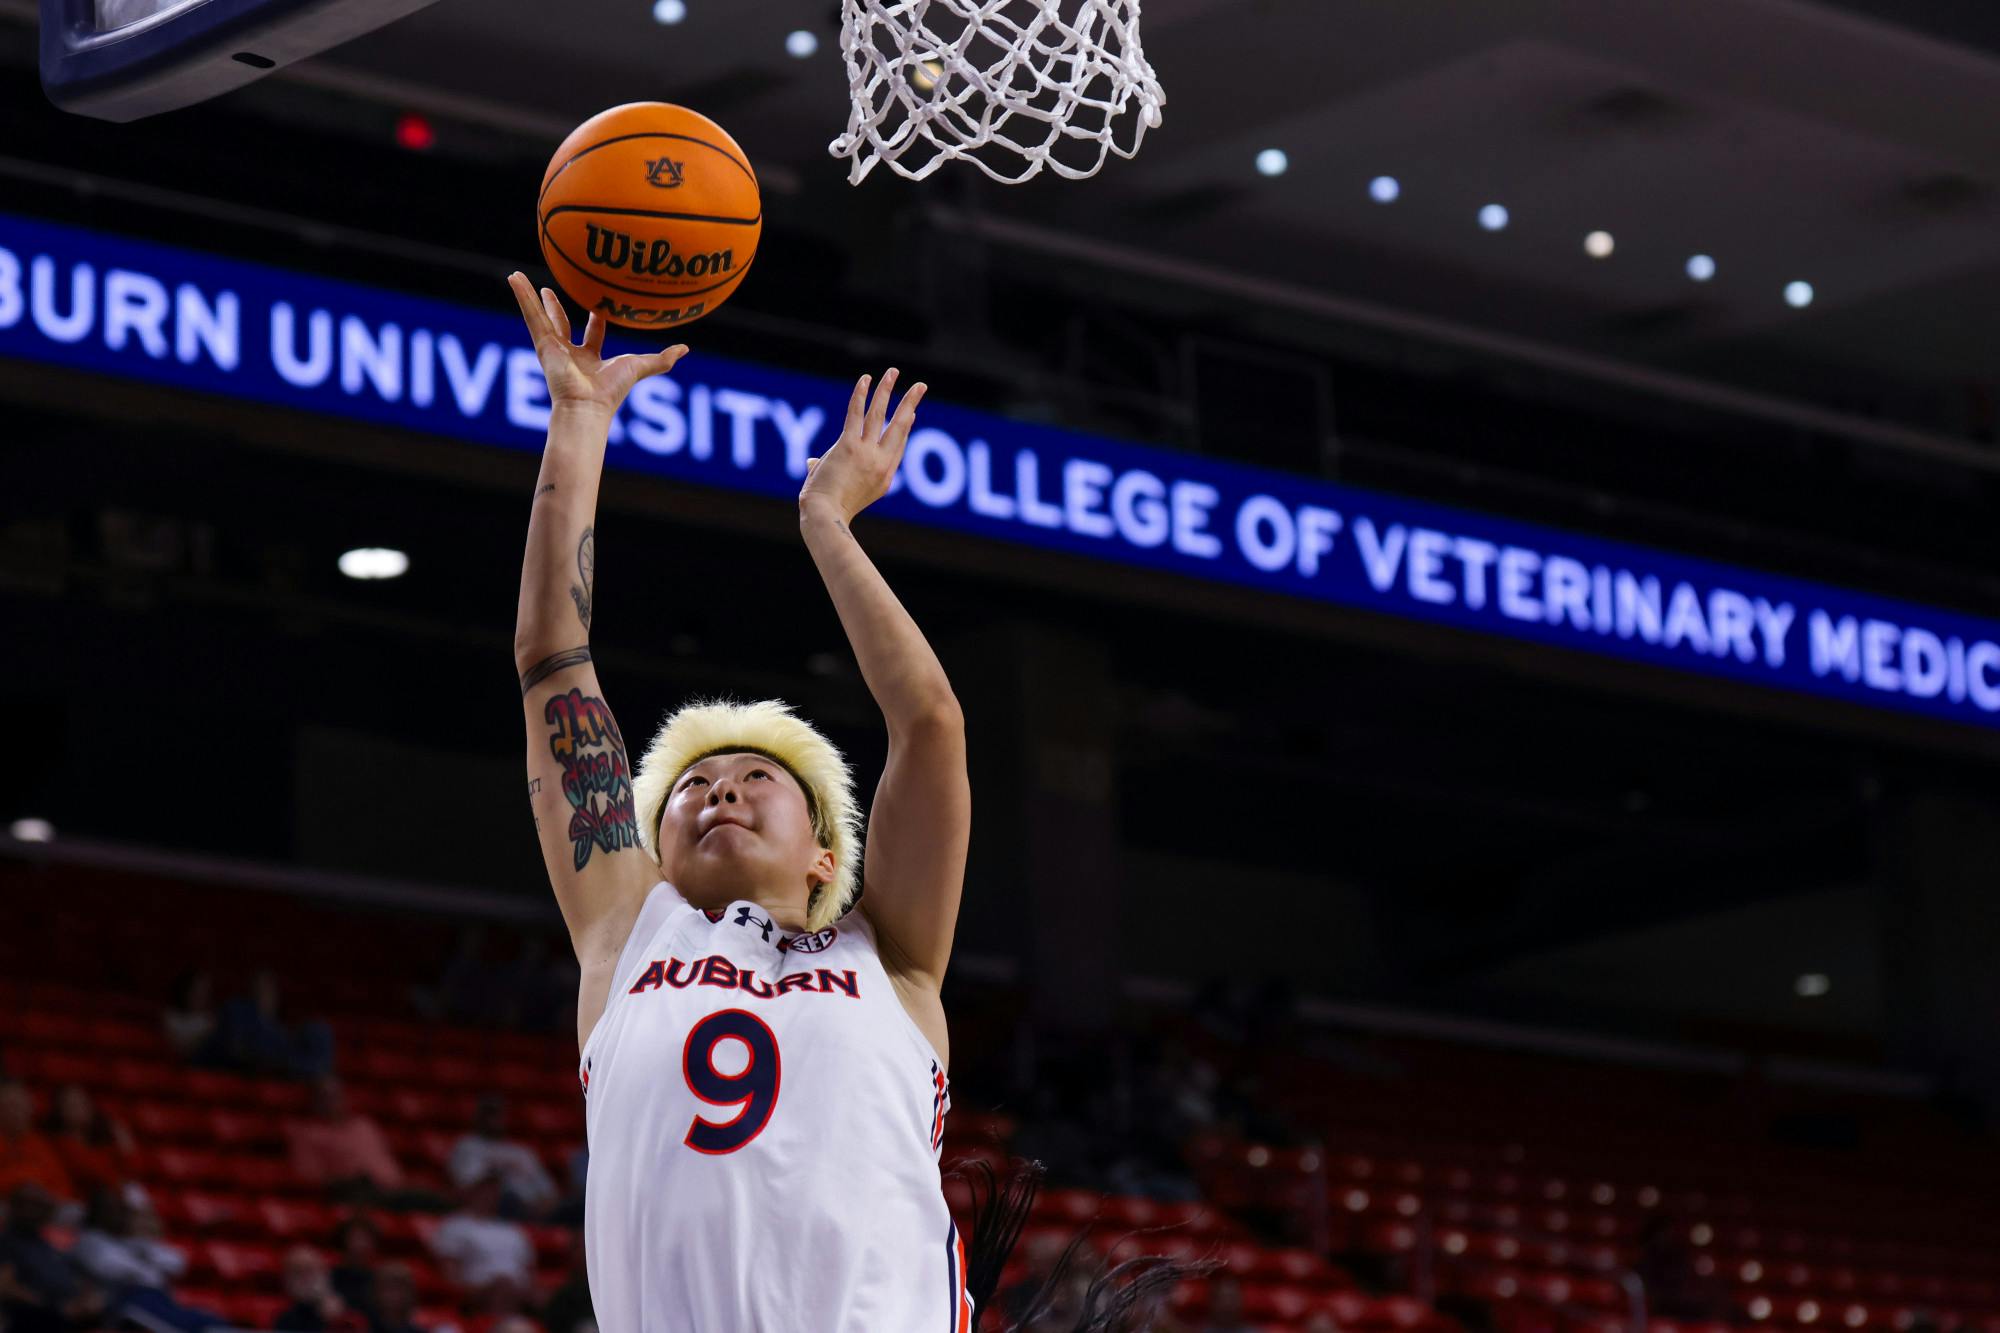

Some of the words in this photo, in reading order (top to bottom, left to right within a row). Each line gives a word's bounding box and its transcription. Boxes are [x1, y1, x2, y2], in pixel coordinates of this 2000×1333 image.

[586, 223, 736, 277] Wilson
[595, 297, 705, 325] NCAA
[270, 301, 825, 479] UNIVESITY
[879, 421, 1223, 559] OLLEGE
[1236, 494, 1343, 576] OF
[1353, 516, 1796, 668] VETERINARY
[1808, 608, 2000, 712] MEDIC
[792, 930, 833, 952] SEC
[628, 955, 861, 999] AUBURN
[682, 1008, 782, 1155] 9
